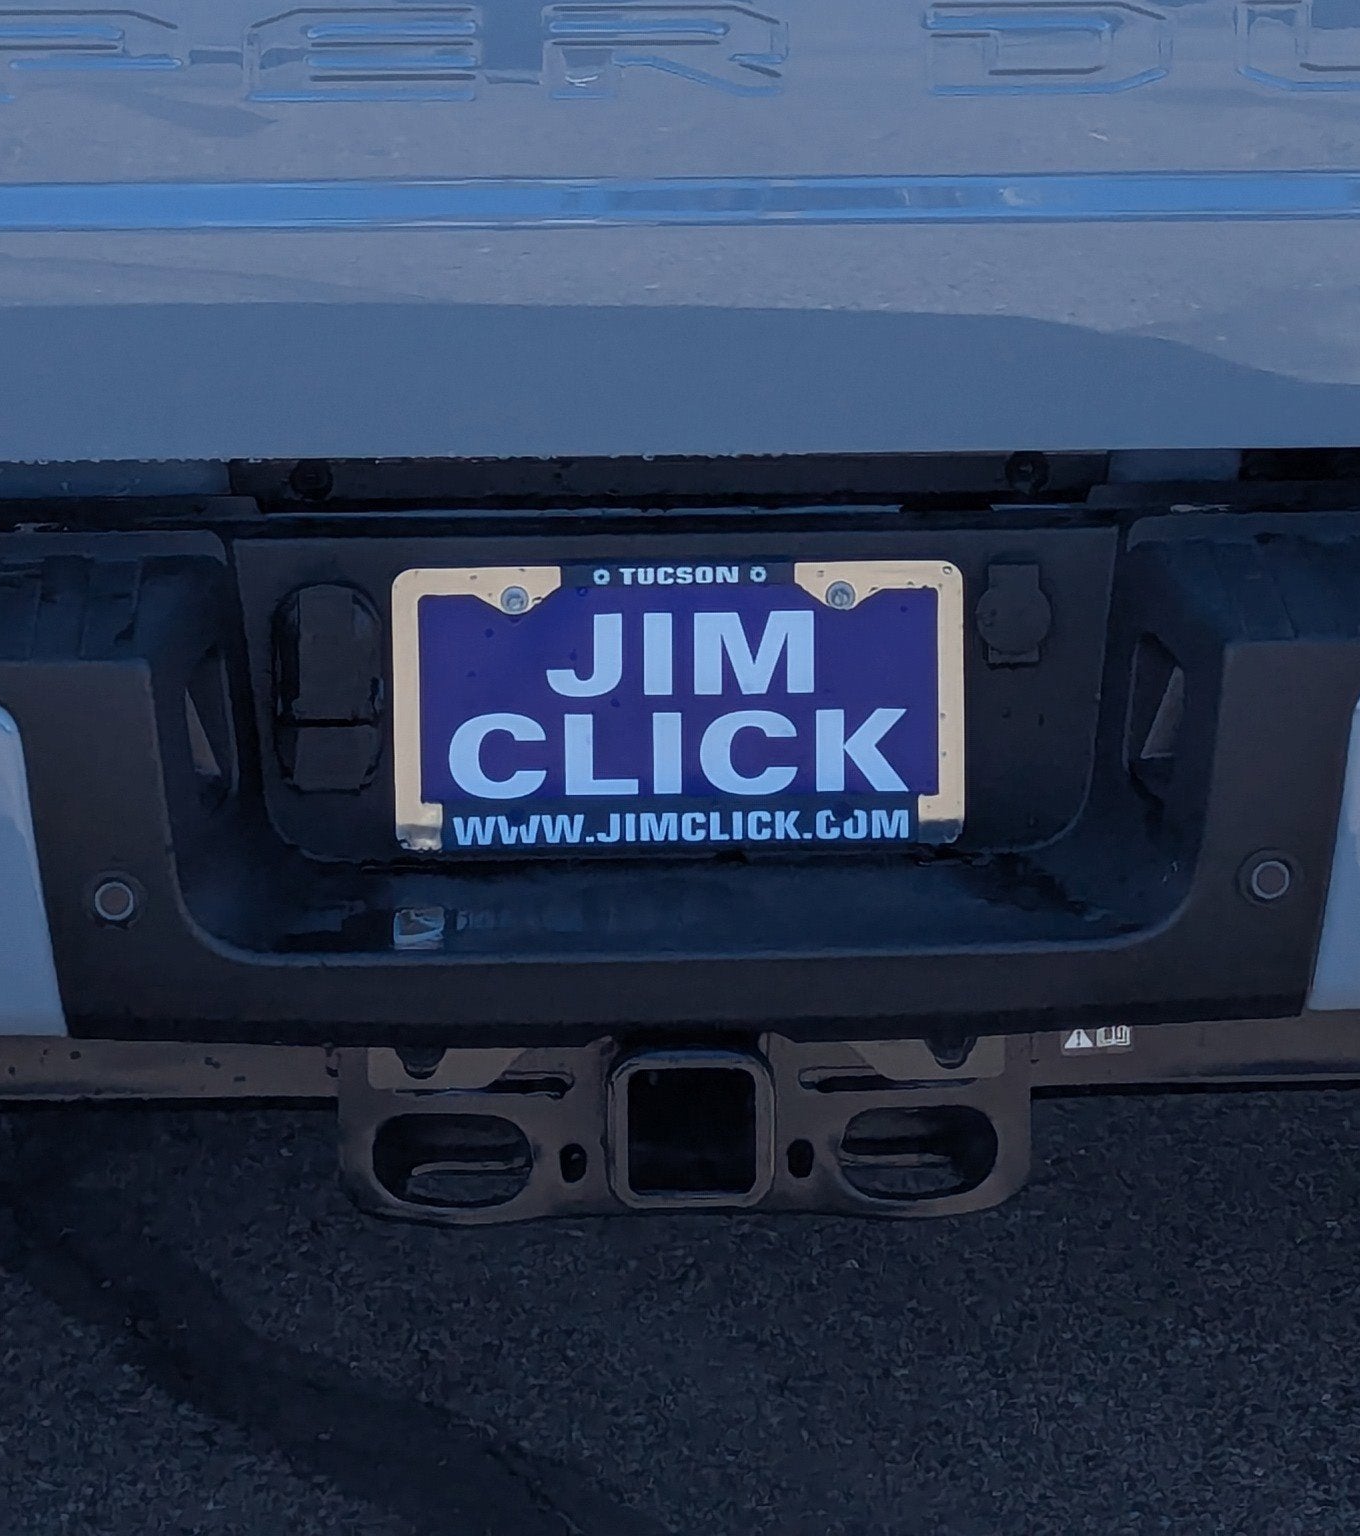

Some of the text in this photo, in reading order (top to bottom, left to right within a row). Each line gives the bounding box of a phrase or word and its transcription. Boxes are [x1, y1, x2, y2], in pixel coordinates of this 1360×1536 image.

[618, 565, 740, 586] TUCSON
[545, 609, 815, 698] JIM
[448, 707, 910, 800] CLICK
[452, 809, 910, 847] WWW.JIMCLICK.COM
